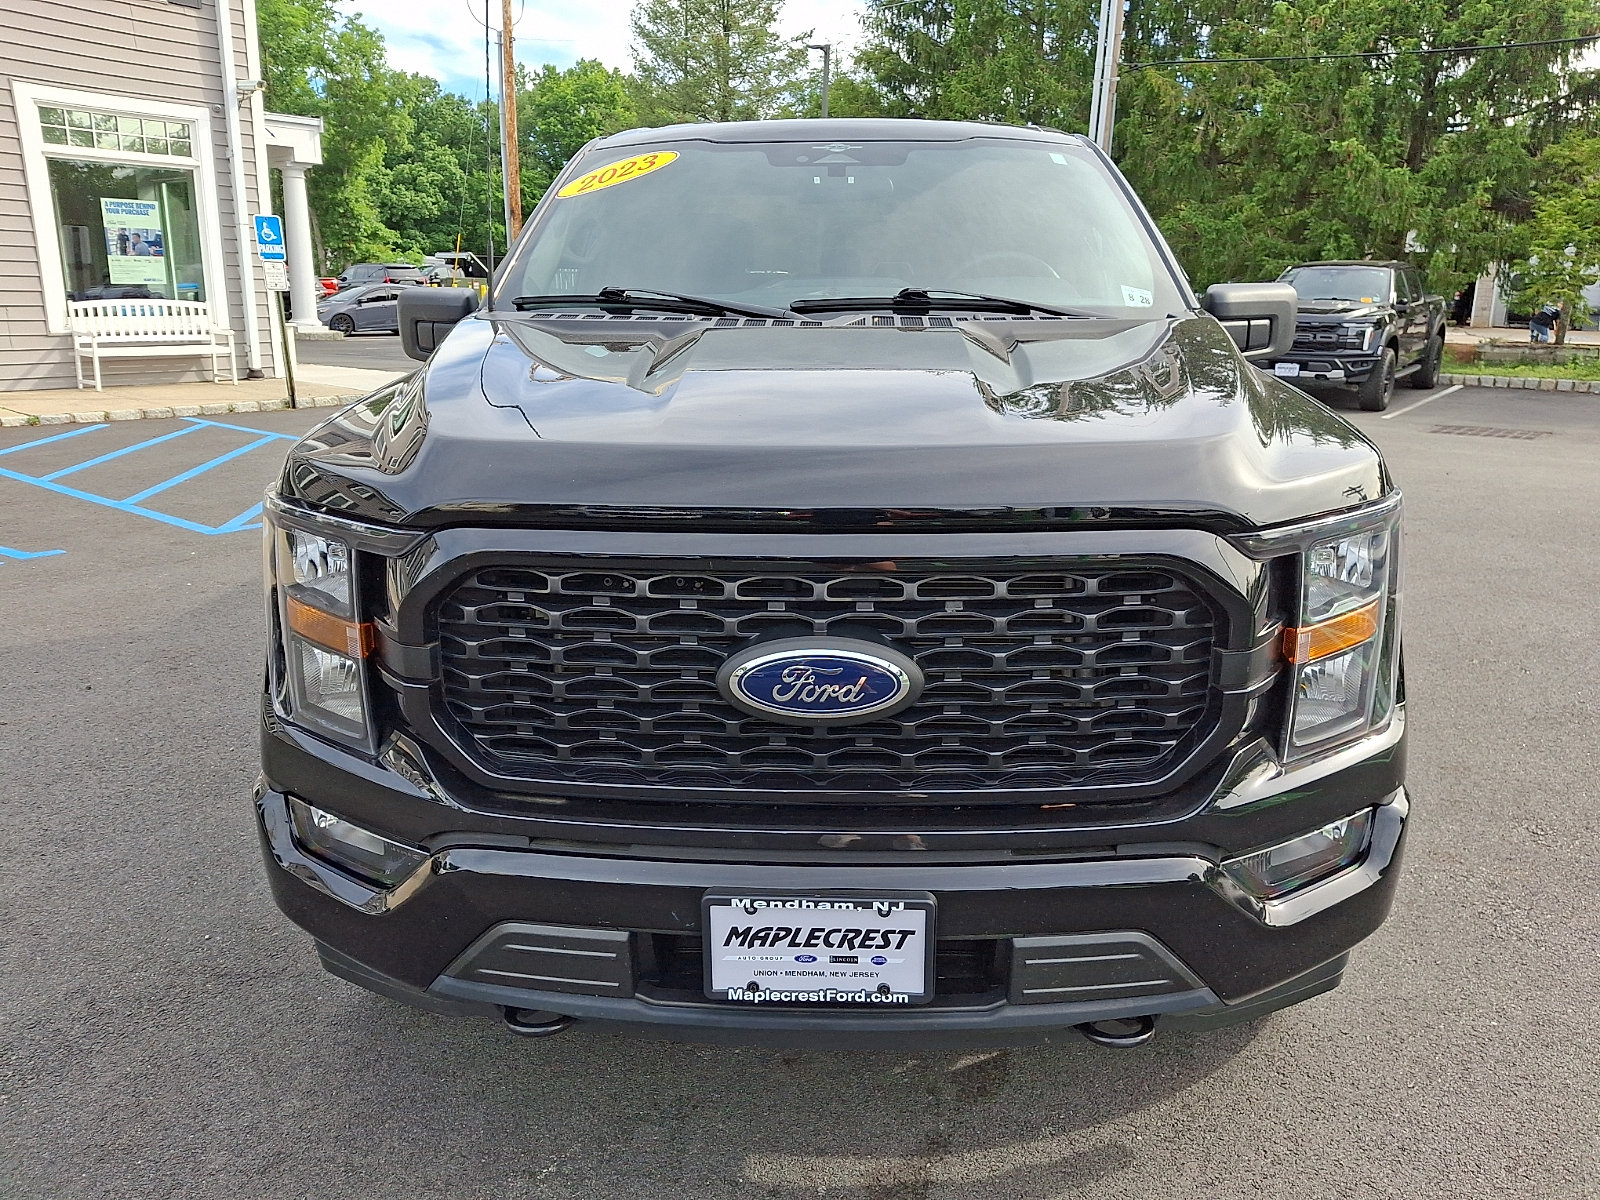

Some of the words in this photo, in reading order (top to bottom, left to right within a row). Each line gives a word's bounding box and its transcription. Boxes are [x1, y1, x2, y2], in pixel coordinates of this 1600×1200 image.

[577, 154, 659, 193] 2023
[105, 200, 109, 208] A
[109, 201, 135, 209] PURPOSE
[135, 202, 156, 210] BEHIND
[105, 207, 120, 215] YOUR
[120, 208, 150, 217] PURCHASE
[258, 244, 284, 254] PARKING
[1128, 293, 1135, 302] 8
[1139, 295, 1151, 305] 28
[772, 665, 868, 703] Ford
[731, 898, 862, 912] Mendham,
[872, 901, 905, 912] NJ
[722, 926, 917, 951] MAPLECREST
[784, 970, 828, 978] MENDHAM,
[727, 988, 910, 1004] MaplecrestFord.com
